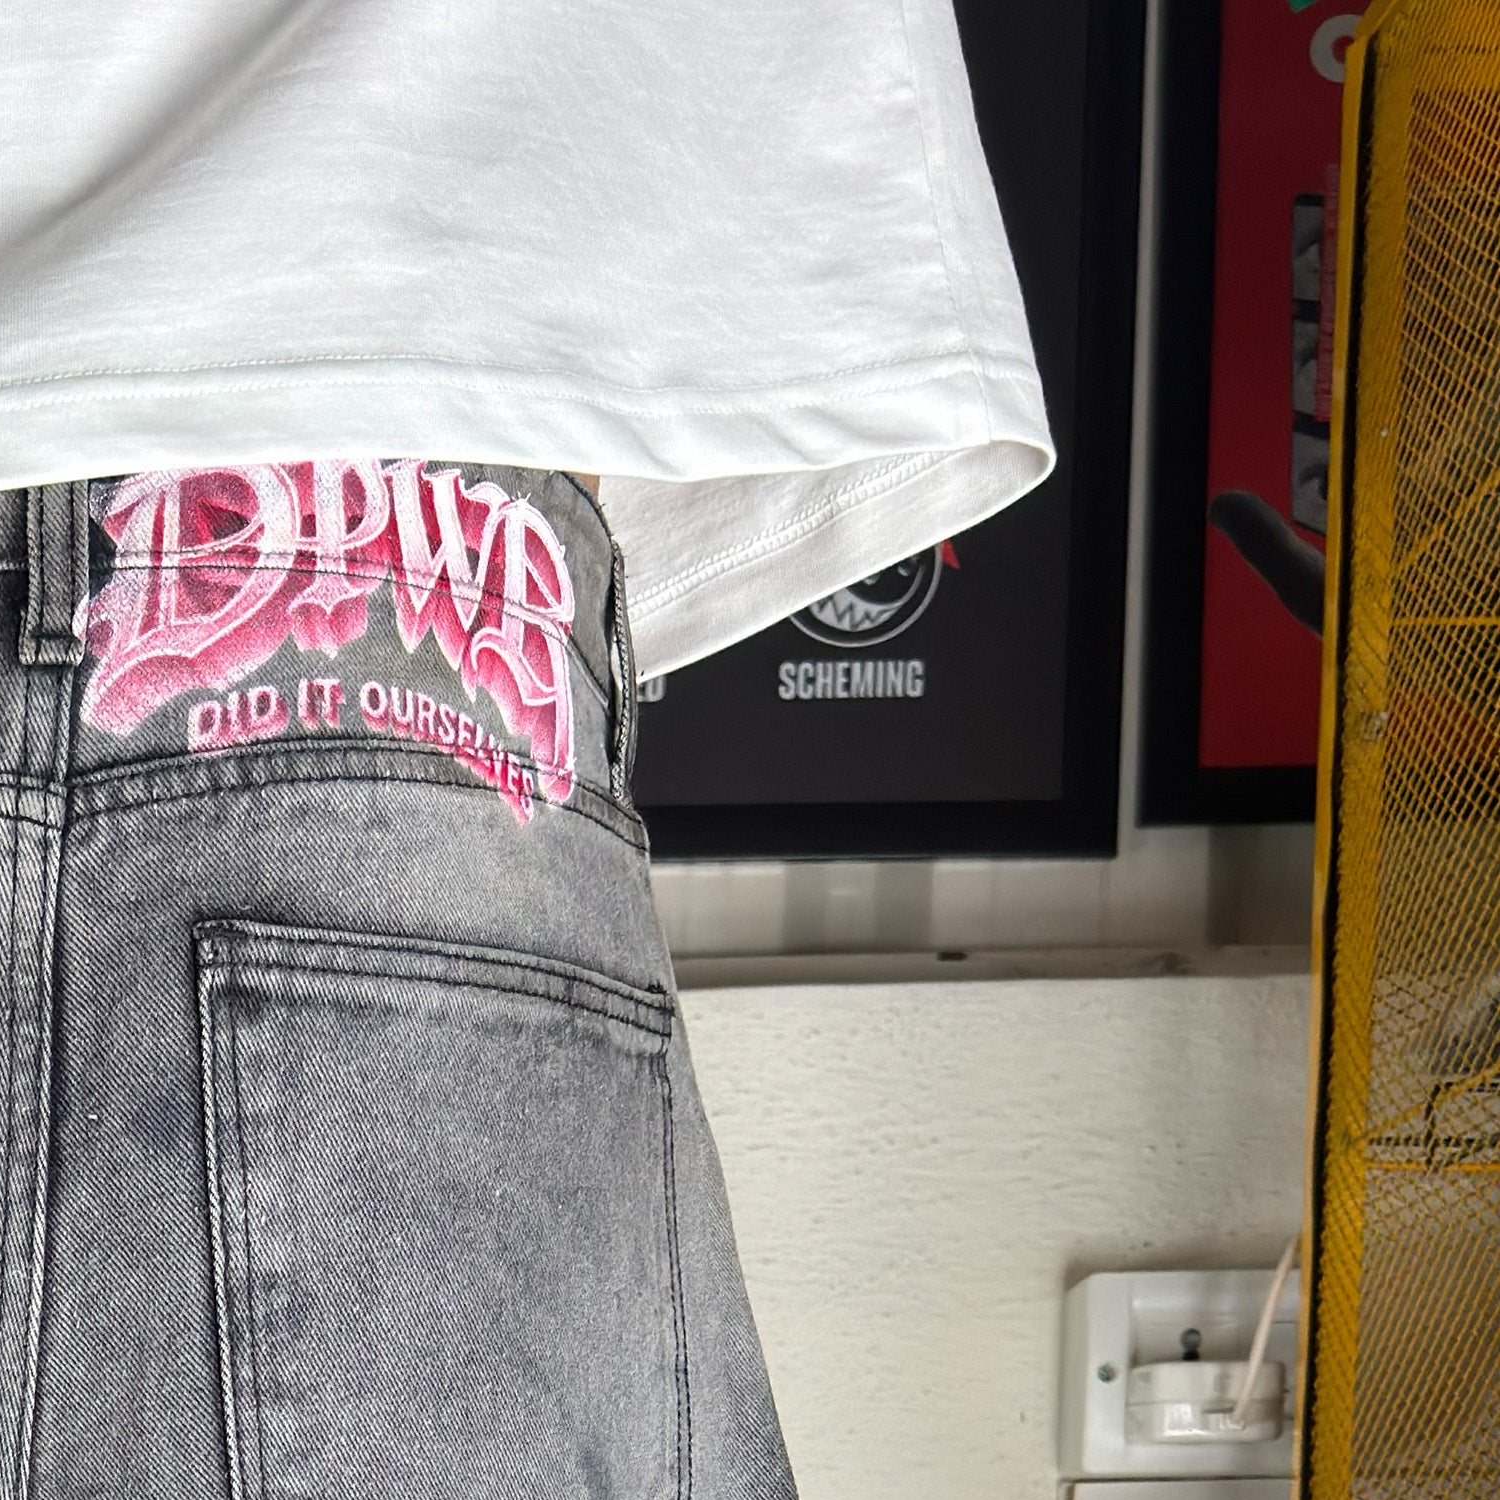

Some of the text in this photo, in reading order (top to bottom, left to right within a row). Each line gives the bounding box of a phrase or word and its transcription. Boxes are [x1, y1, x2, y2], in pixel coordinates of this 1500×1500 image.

[777, 659, 925, 700] SCHEMING
[187, 685, 286, 753] DID
[299, 678, 346, 729] IT
